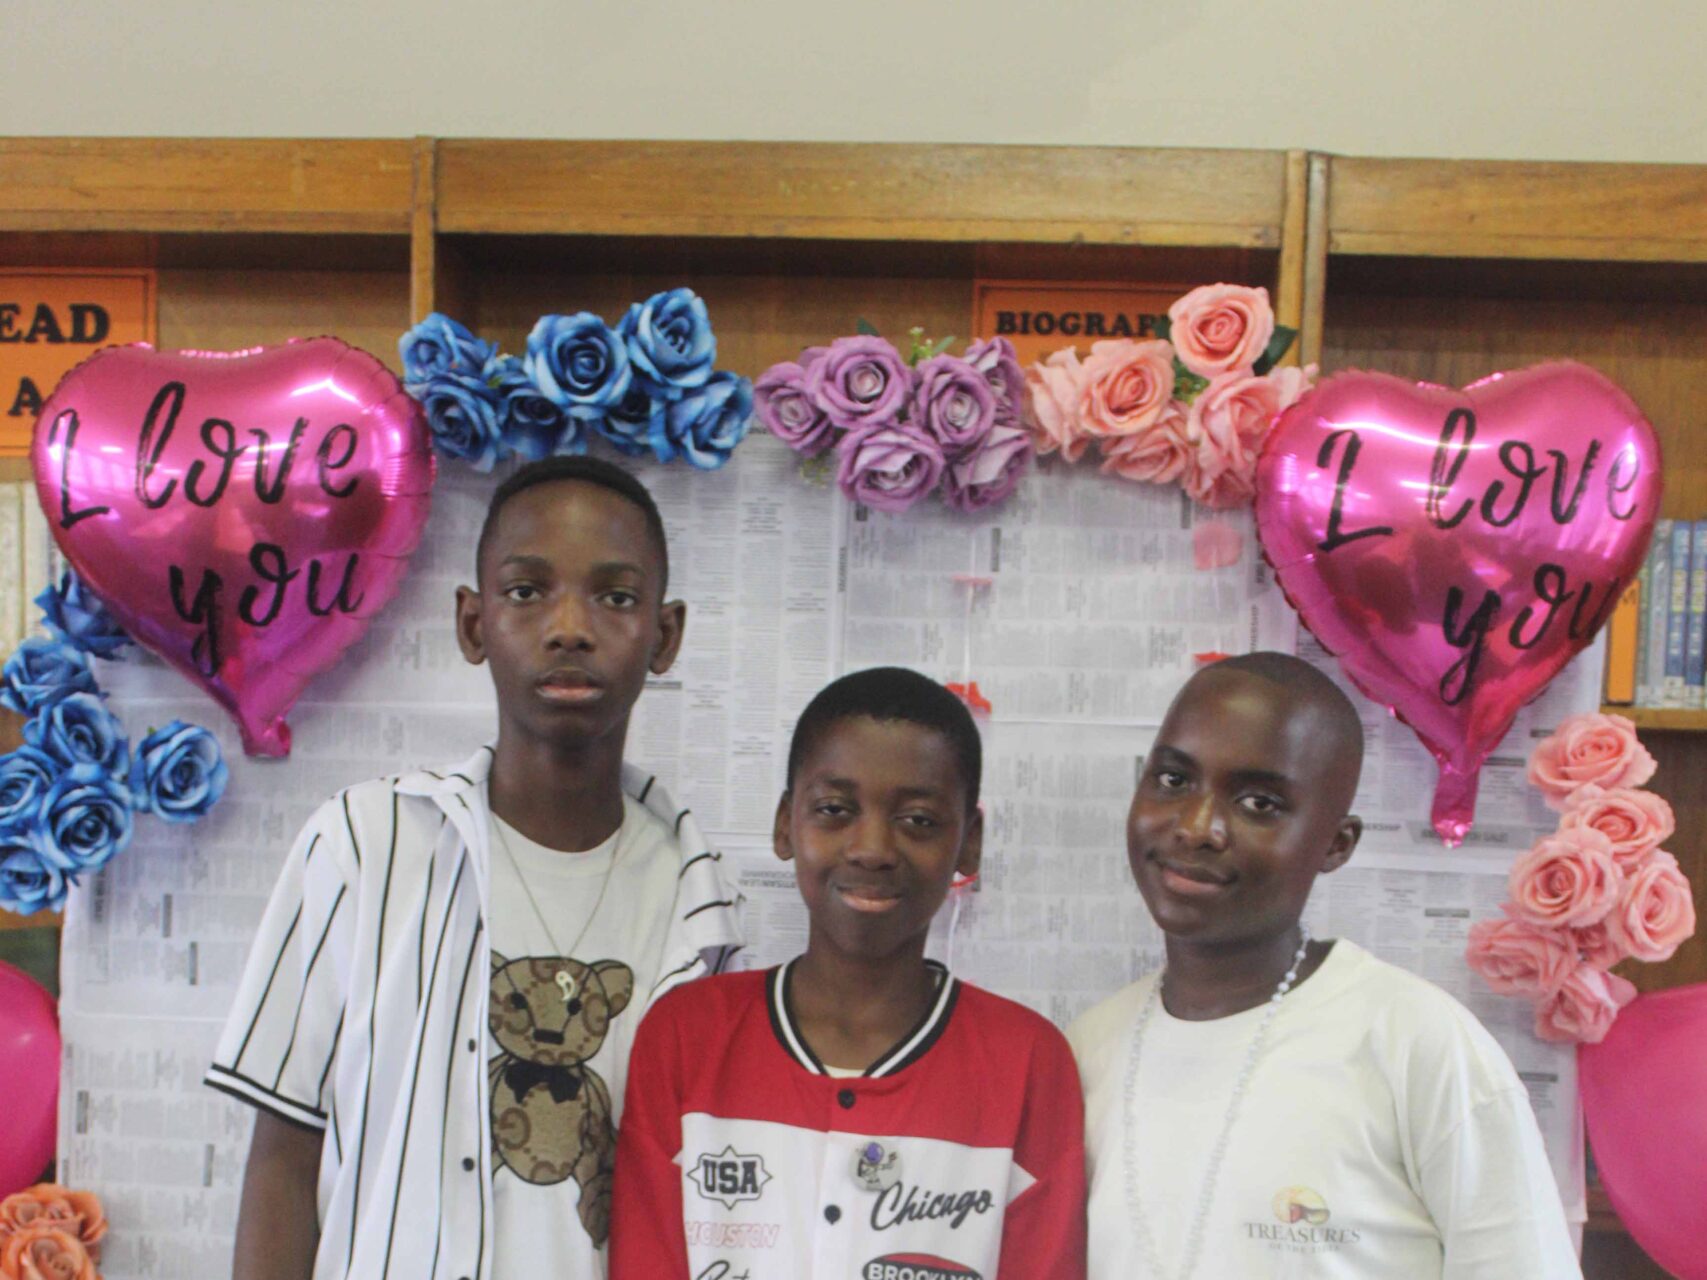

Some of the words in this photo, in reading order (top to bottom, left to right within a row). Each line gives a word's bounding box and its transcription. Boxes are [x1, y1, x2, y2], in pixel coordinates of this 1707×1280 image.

[996, 311, 1168, 337] BIOGRAP
[136, 381, 359, 509] love
[1425, 407, 1642, 528] love
[169, 543, 365, 678] you
[702, 1159, 759, 1195] USA
[870, 1180, 995, 1231] Chicago
[1244, 1222, 1361, 1244] TREASURES
